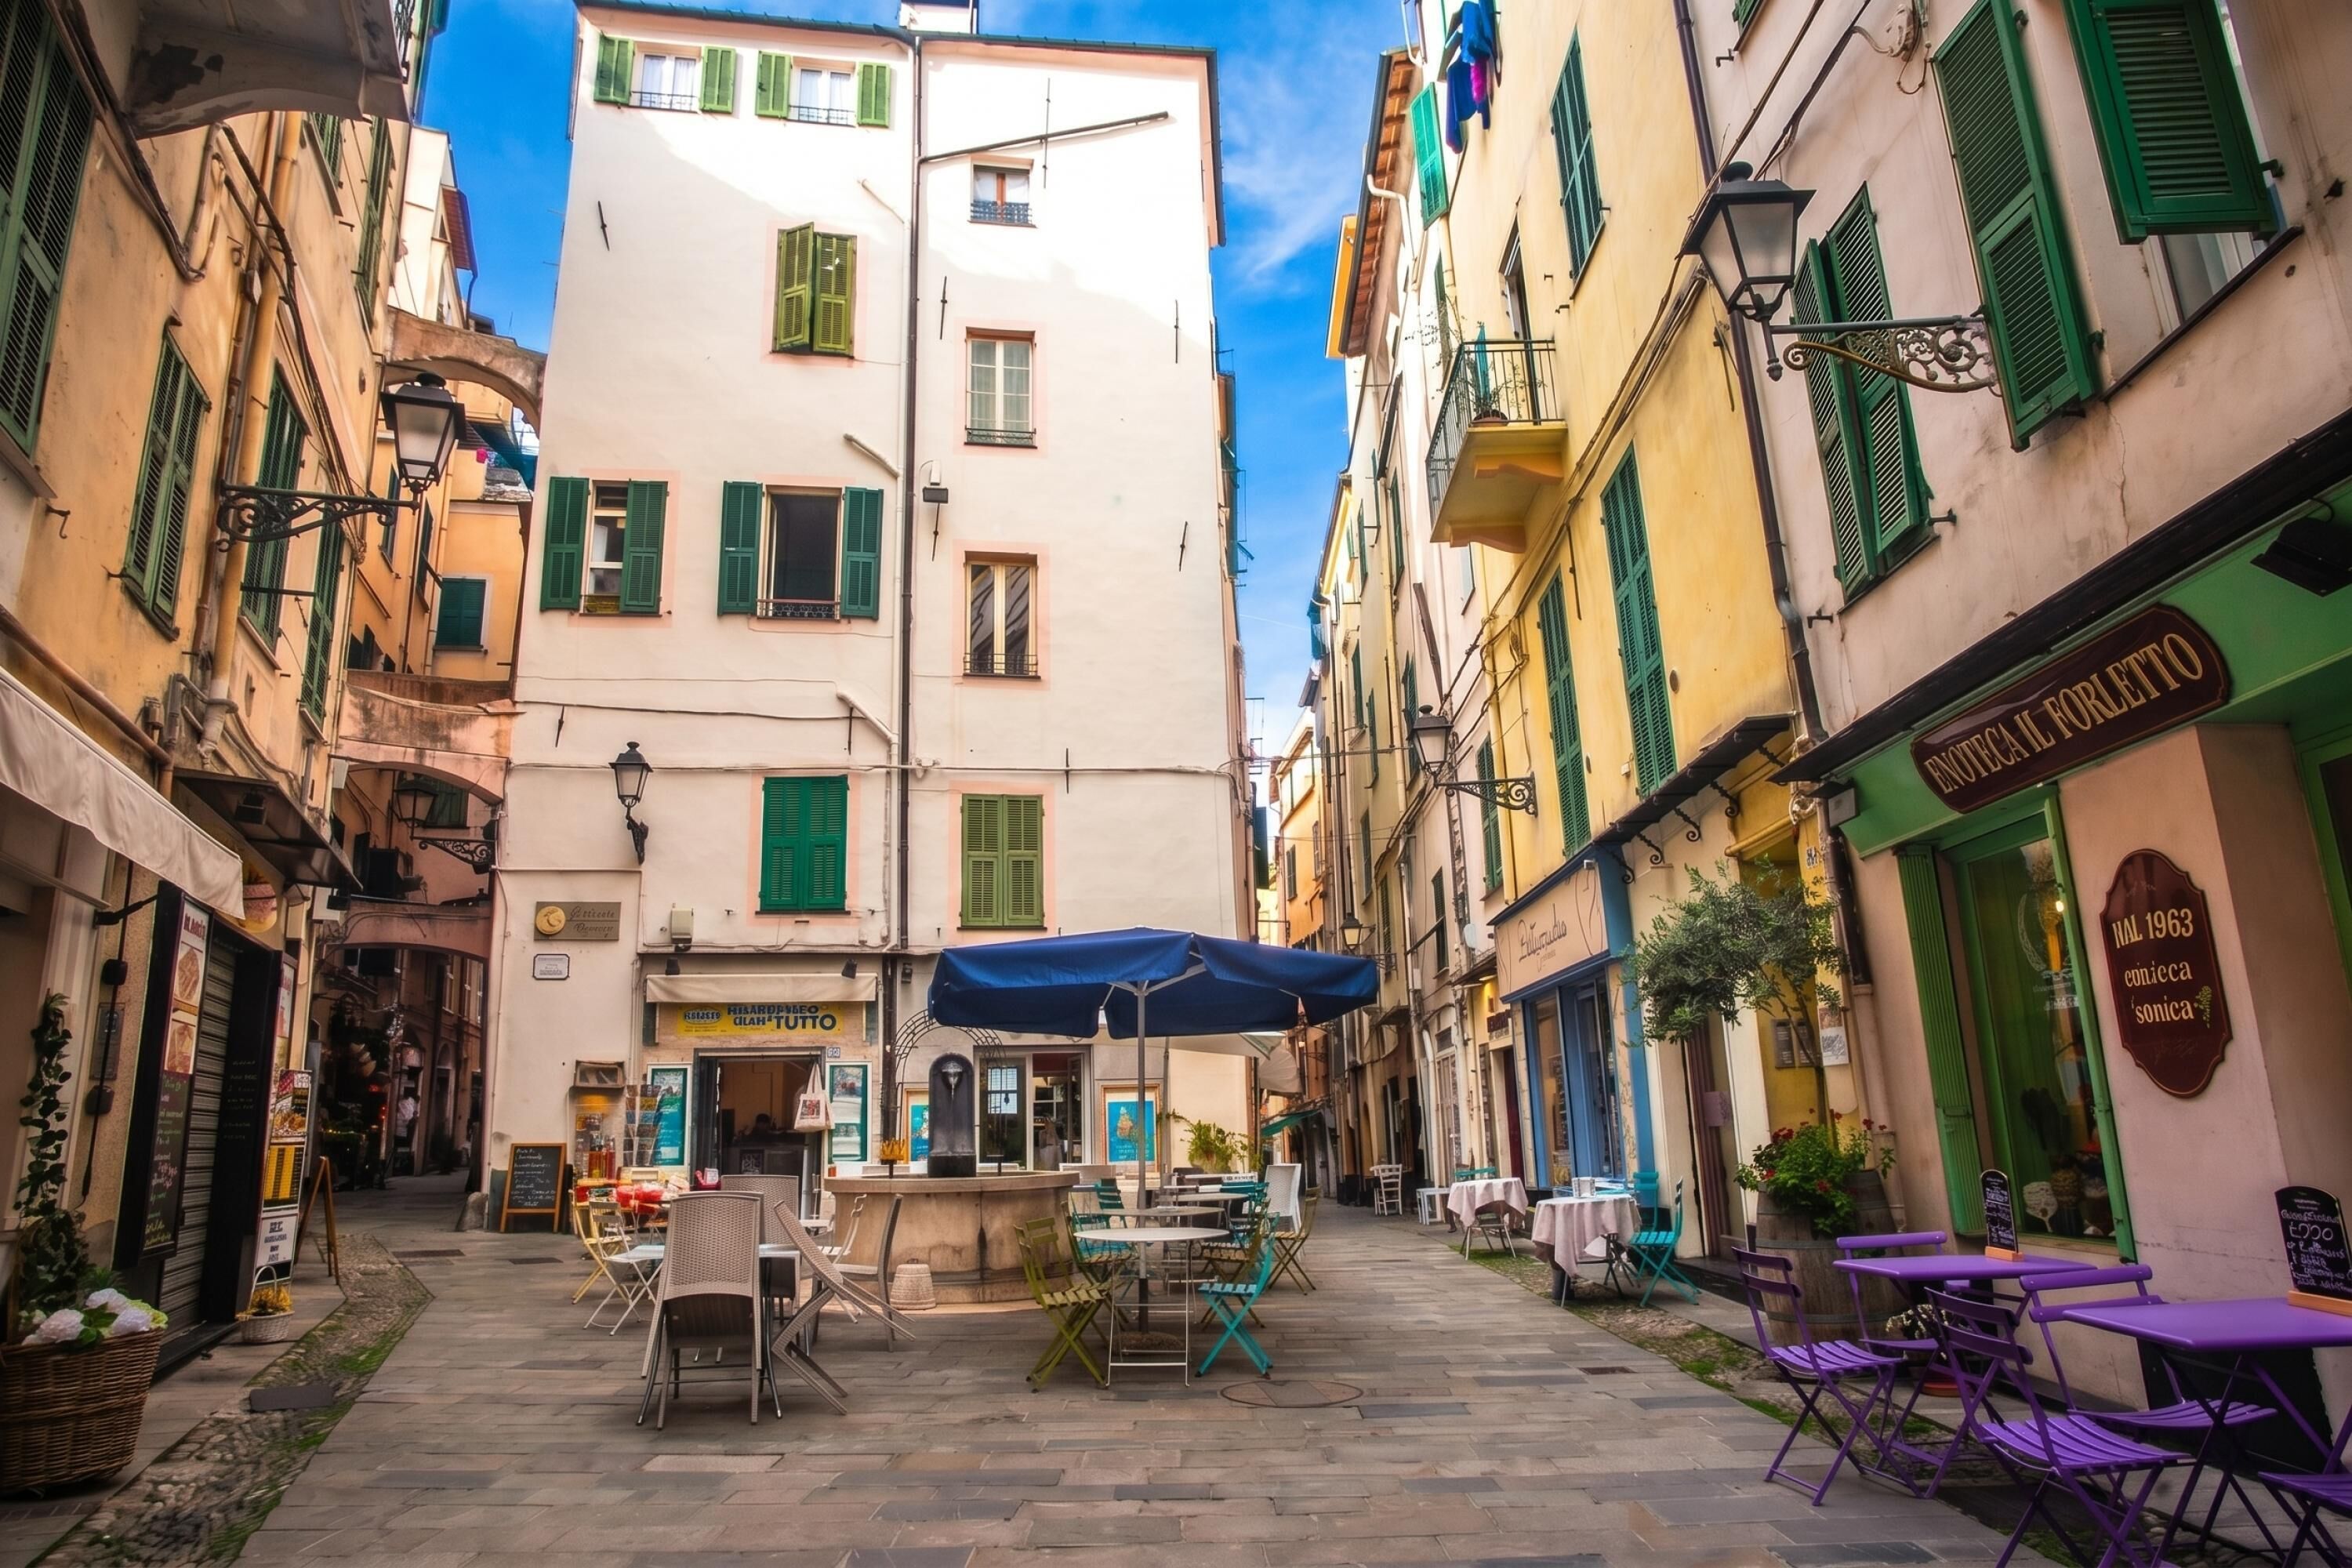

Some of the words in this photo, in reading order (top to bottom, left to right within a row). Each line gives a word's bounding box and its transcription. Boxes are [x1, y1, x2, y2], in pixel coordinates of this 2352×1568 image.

[1924, 722, 2030, 793] ENOTECA
[2014, 710, 2056, 753] IL
[2042, 633, 2203, 739] FORLETTO
[2146, 908, 2194, 940] 1963
[774, 1014, 837, 1030] TUTTO
[2136, 996, 2194, 1025] sonica
